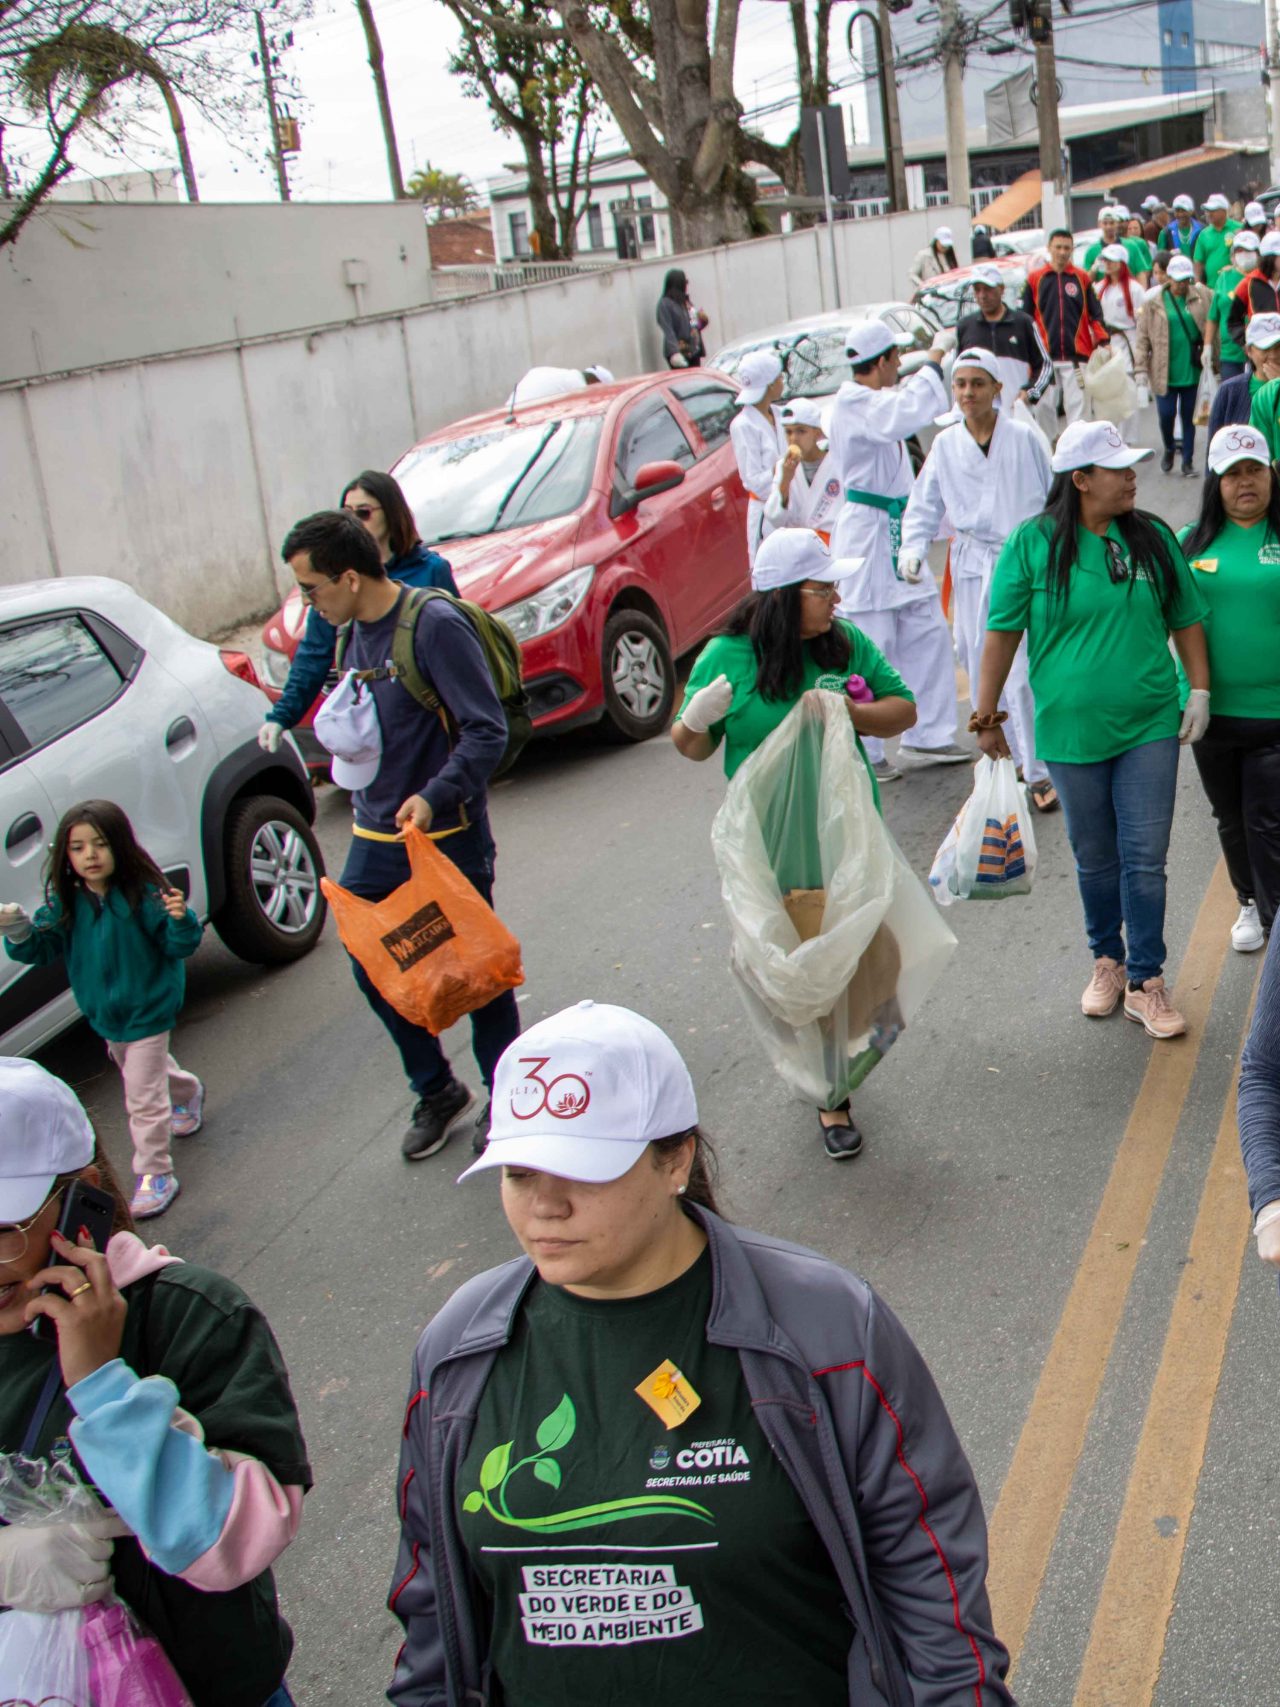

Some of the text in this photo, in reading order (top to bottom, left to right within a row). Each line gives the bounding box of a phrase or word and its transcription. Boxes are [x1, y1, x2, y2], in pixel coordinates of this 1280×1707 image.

[1226, 431, 1255, 450] 30
[509, 1057, 591, 1120] 30
[676, 1446, 750, 1469] COTIA
[645, 1470, 751, 1488] SECRETARIA DE SAÚDE
[533, 1569, 667, 1587] SECRETARIA
[529, 1590, 683, 1613] DO VERDE E DO
[531, 1611, 693, 1641] MEIO AMBIENTE
